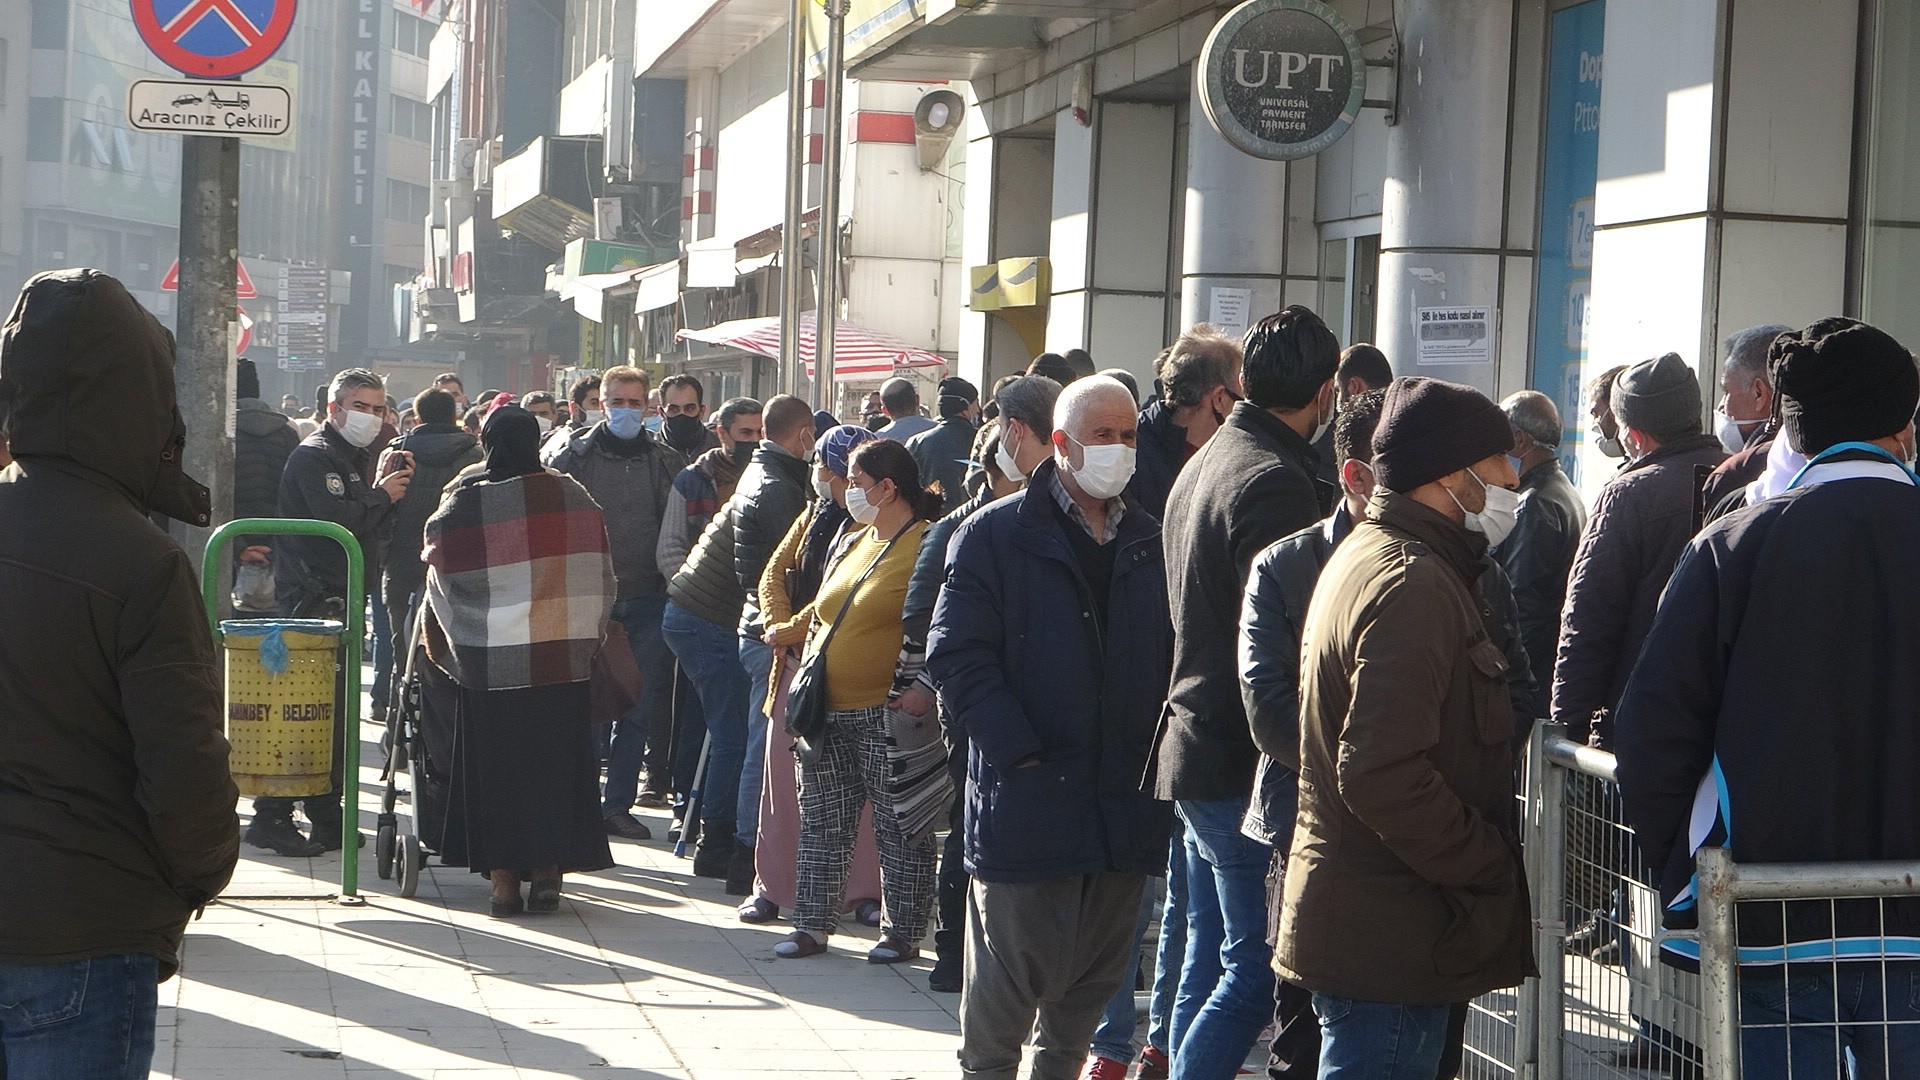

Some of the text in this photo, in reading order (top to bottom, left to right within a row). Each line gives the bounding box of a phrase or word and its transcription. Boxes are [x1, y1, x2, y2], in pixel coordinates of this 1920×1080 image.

[1232, 49, 1344, 92] UPT
[1260, 98, 1310, 108] UNIVERSAL
[139, 108, 282, 129] Aracınız Çekilir
[1262, 109, 1306, 119] PAYMENT
[1261, 119, 1307, 130] TRANSFER
[1422, 311, 1431, 321] SMS
[1447, 310, 1459, 320] kodu
